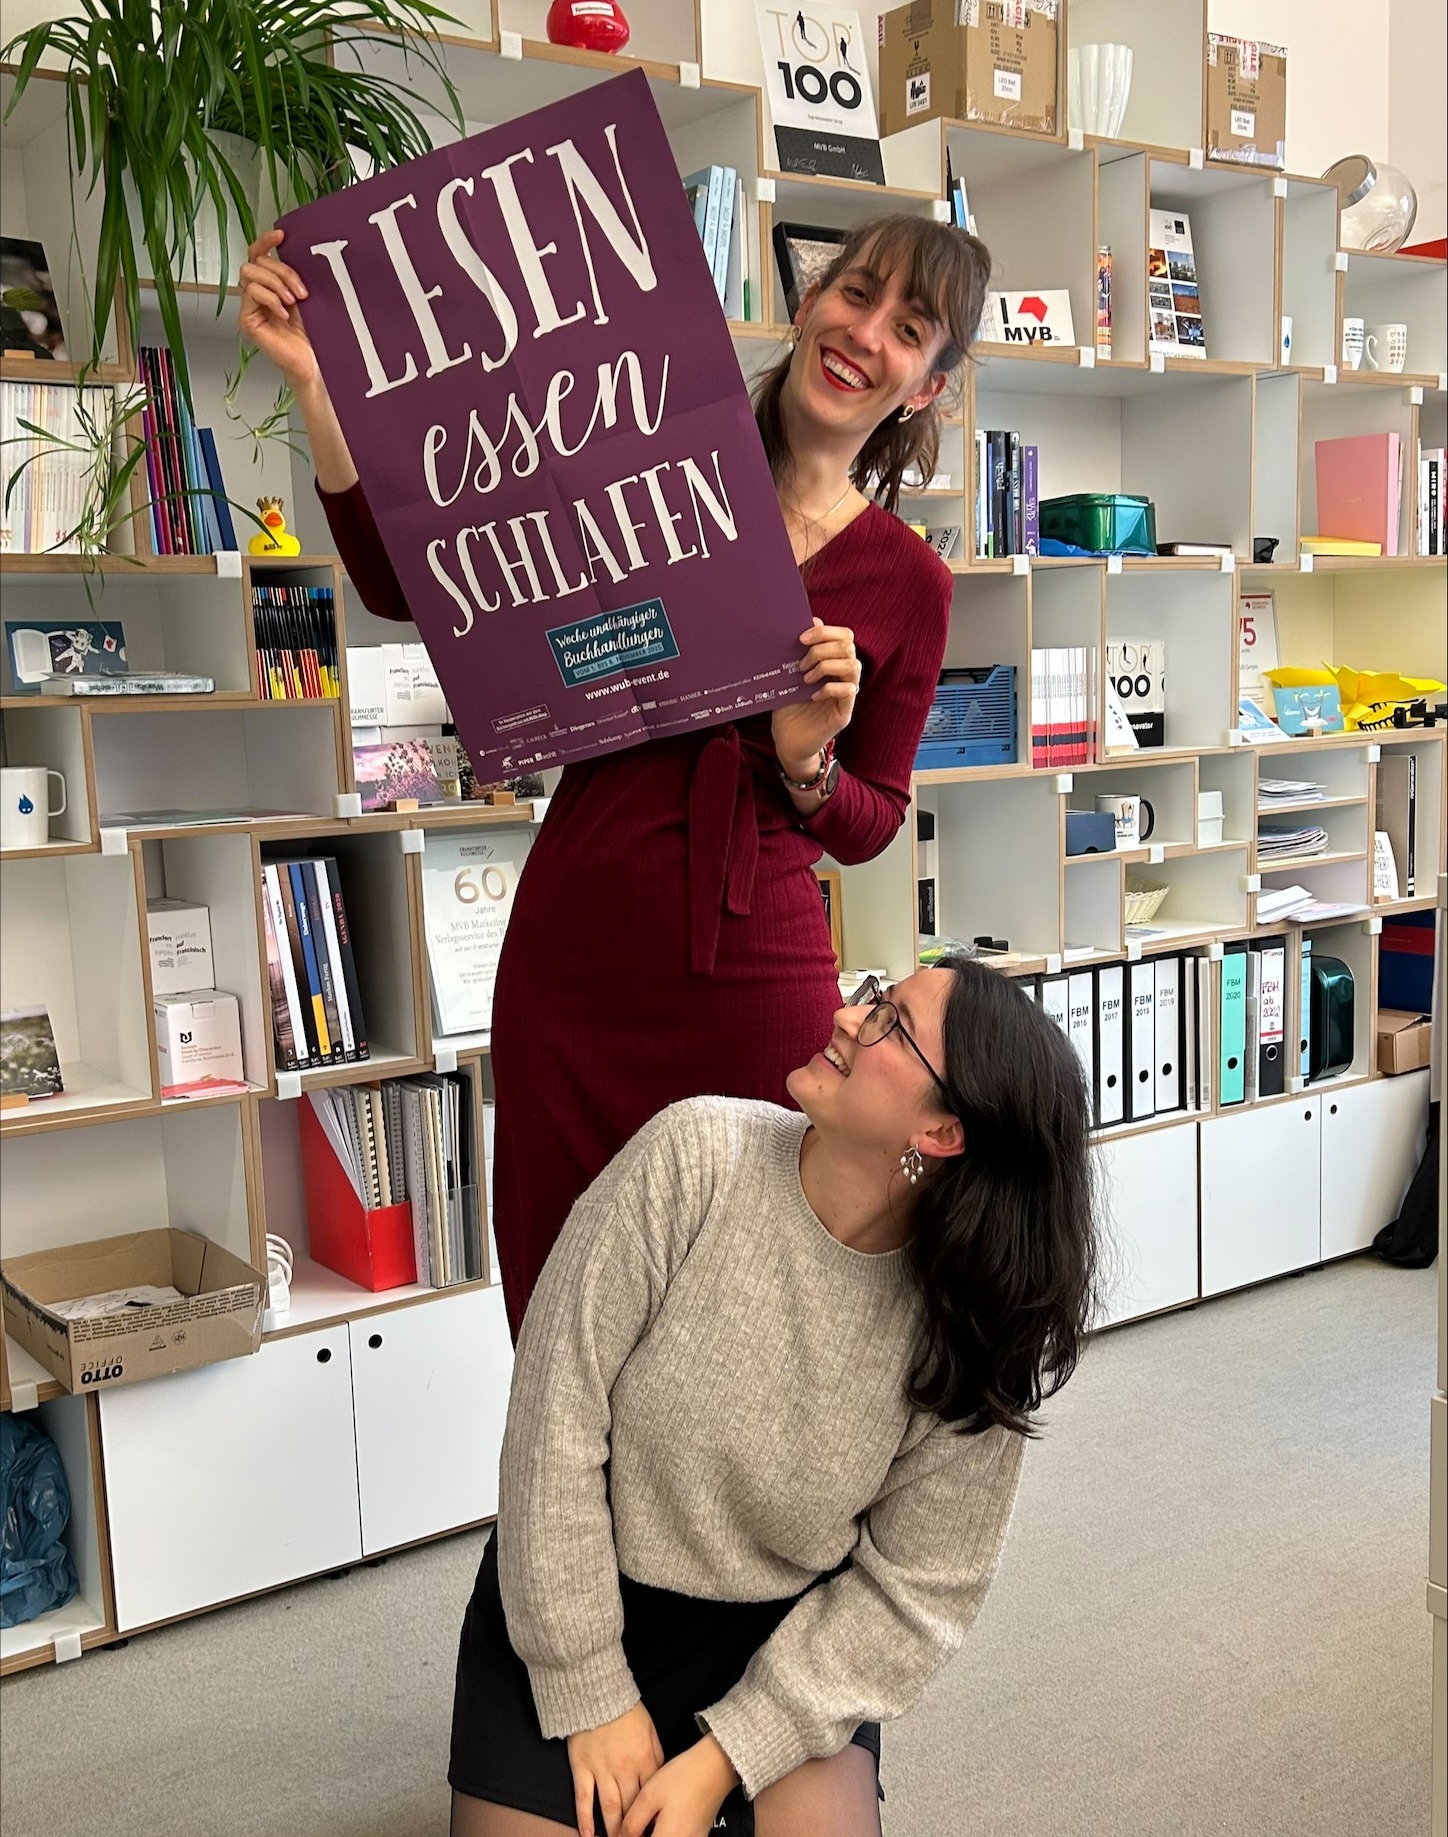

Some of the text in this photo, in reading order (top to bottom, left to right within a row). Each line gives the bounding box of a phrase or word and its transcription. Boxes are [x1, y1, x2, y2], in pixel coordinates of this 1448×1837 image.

[766, 10, 851, 68] TOP
[778, 60, 862, 110] 100
[311, 124, 658, 398] LESEN
[1000, 298, 1009, 324] I
[1004, 326, 1053, 343] MVB
[424, 350, 669, 506] essen
[426, 450, 740, 638] SCHLAFEN
[556, 628, 589, 649] Woche
[564, 628, 664, 668] Buchhandlungen
[585, 670, 670, 700] www.wub-event.de
[454, 866, 508, 904] 60
[475, 906, 496, 914] Jahre
[451, 918, 507, 931] MVB Marketing
[435, 931, 485, 944] Verlagsservice
[1227, 978, 1241, 986] FBM
[1134, 994, 1152, 1005] FBM
[1160, 988, 1174, 997] FBM
[1226, 991, 1241, 1000] 2020
[1102, 999, 1120, 1010] FBM
[1160, 998, 1174, 1007] 2019
[1071, 1006, 1089, 1018] FBM
[1104, 1012, 1118, 1021] 2017
[81, 1355, 123, 1371] OFFICE
[81, 1364, 123, 1384] OTTO
[712, 1816, 726, 1828] LA
